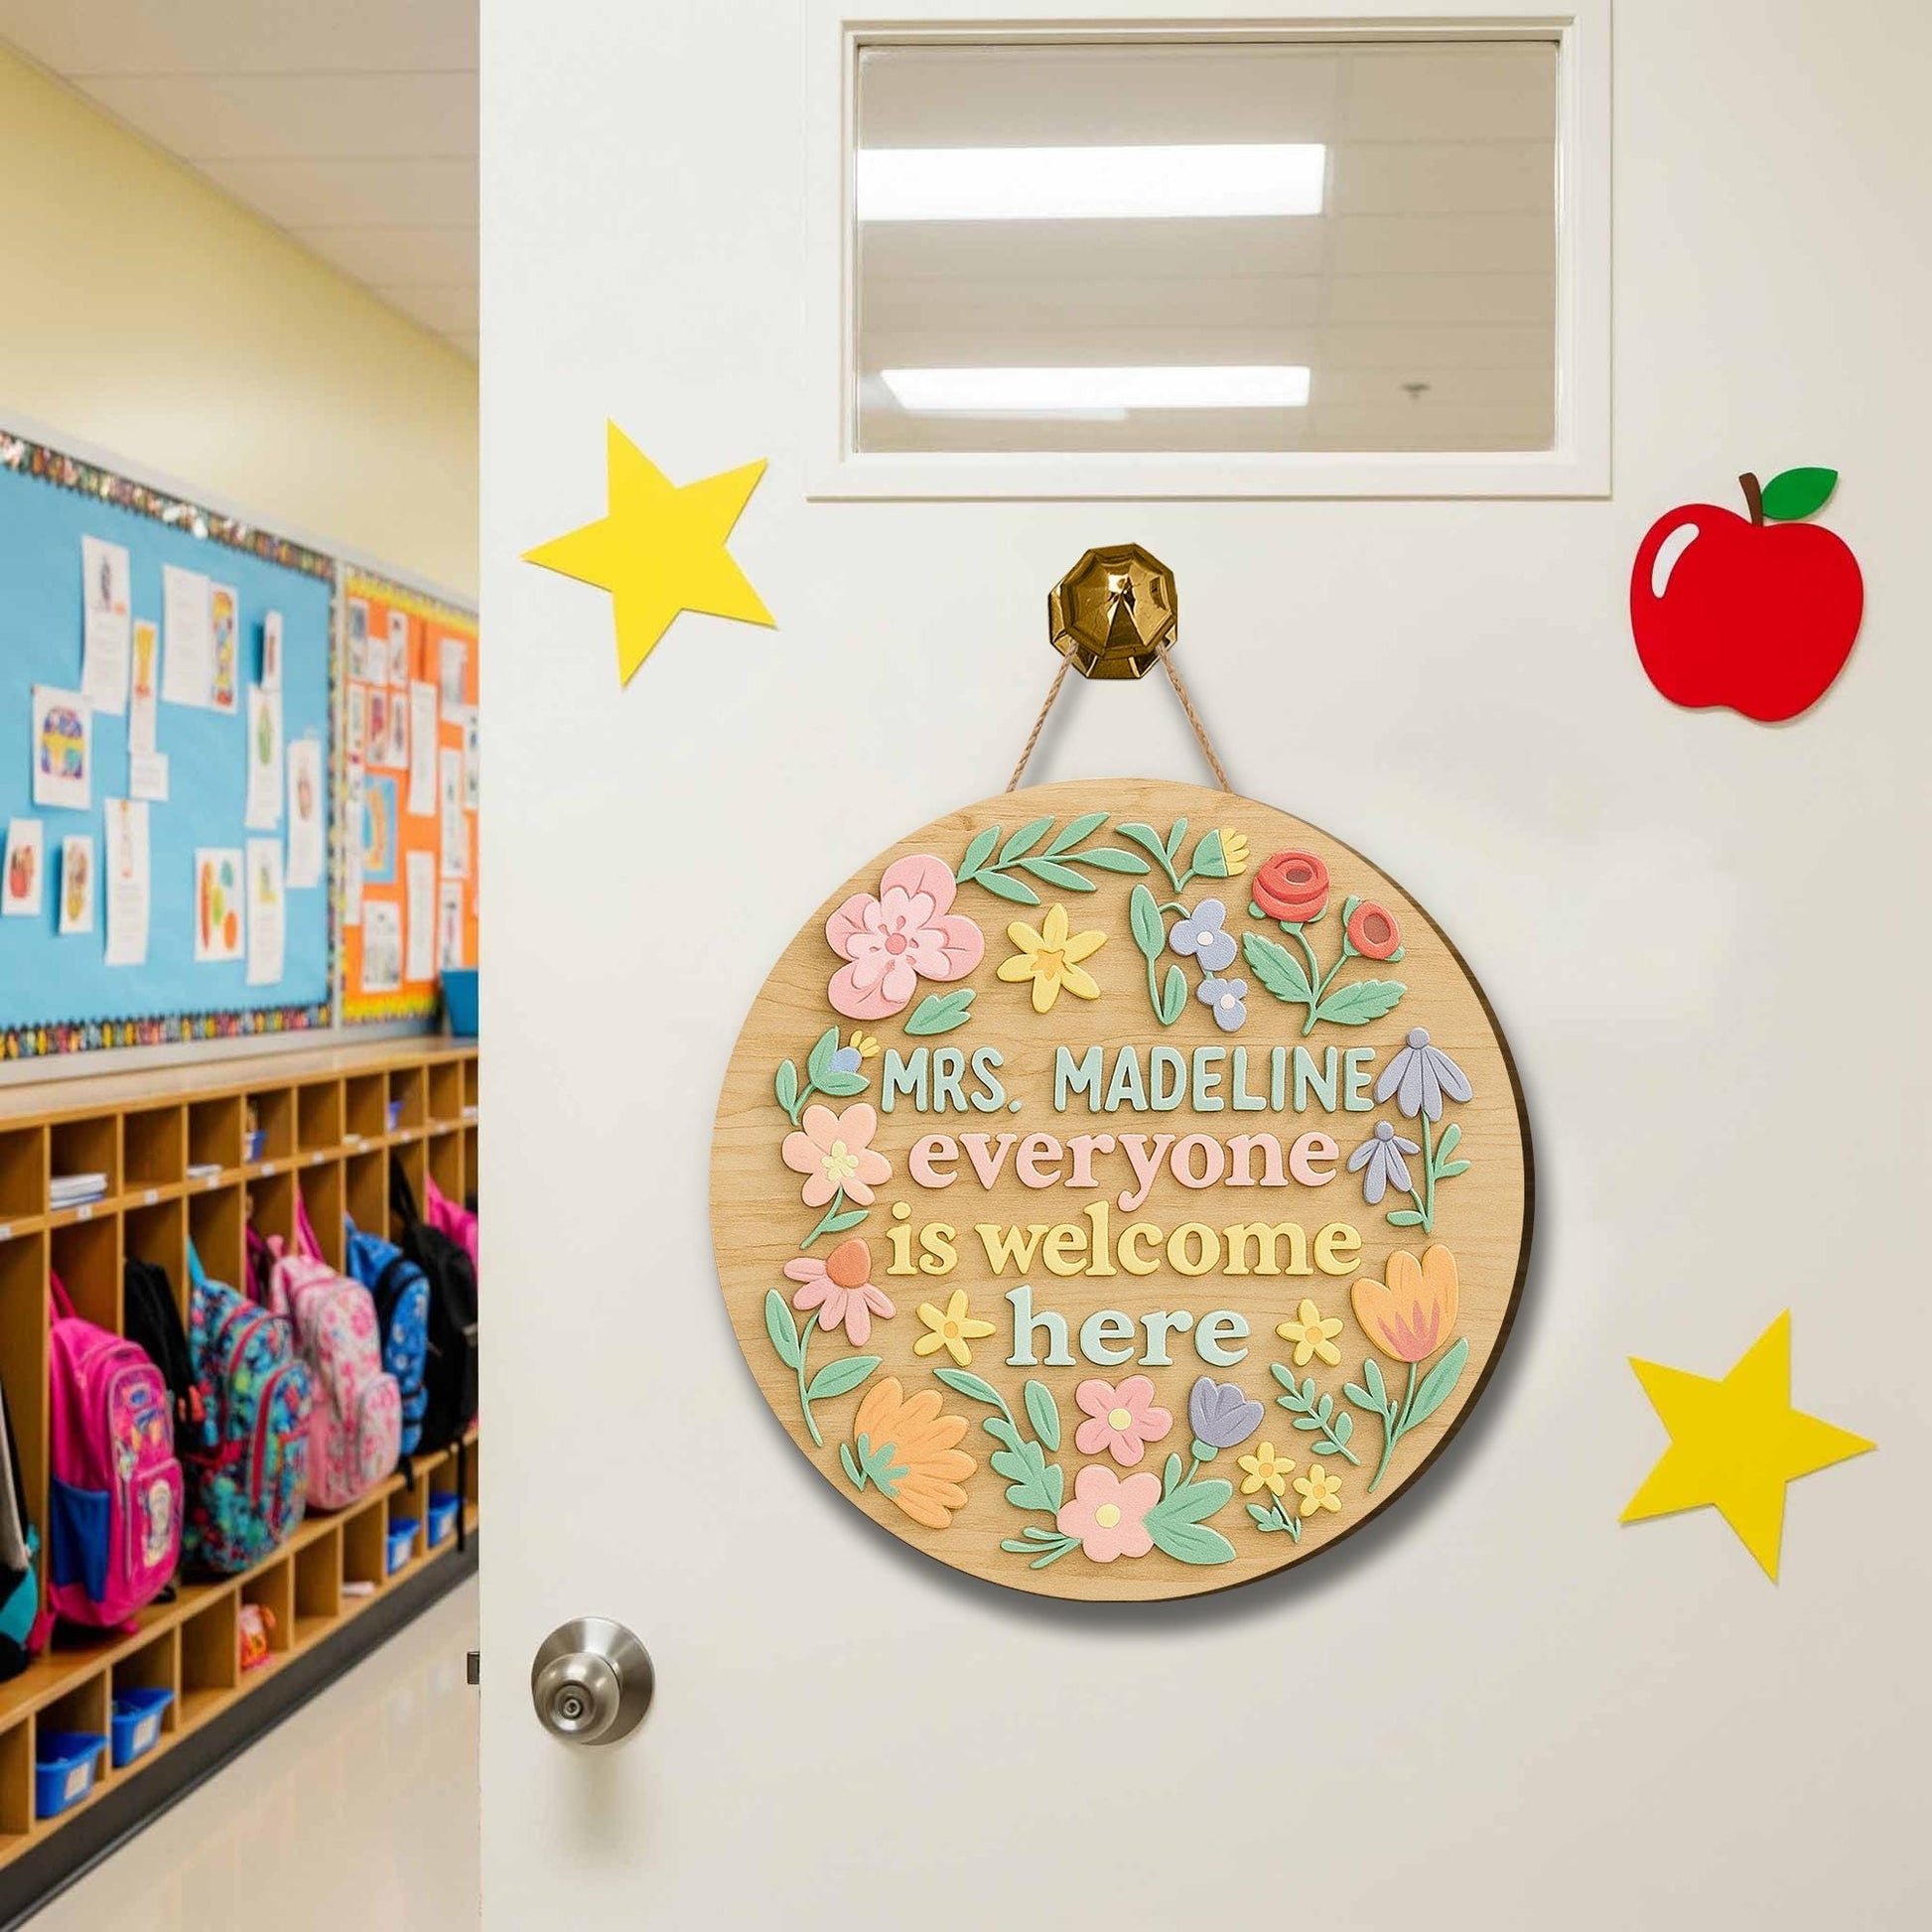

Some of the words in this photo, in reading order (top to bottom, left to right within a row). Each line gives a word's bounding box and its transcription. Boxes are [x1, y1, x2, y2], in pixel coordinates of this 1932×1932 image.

[881, 1045, 1023, 1114] MRS.
[1052, 1045, 1375, 1113] MADELINE
[907, 1131, 1339, 1212] everyone
[887, 1201, 958, 1276] is
[974, 1200, 1362, 1276] welcome
[1005, 1285, 1252, 1367] here
